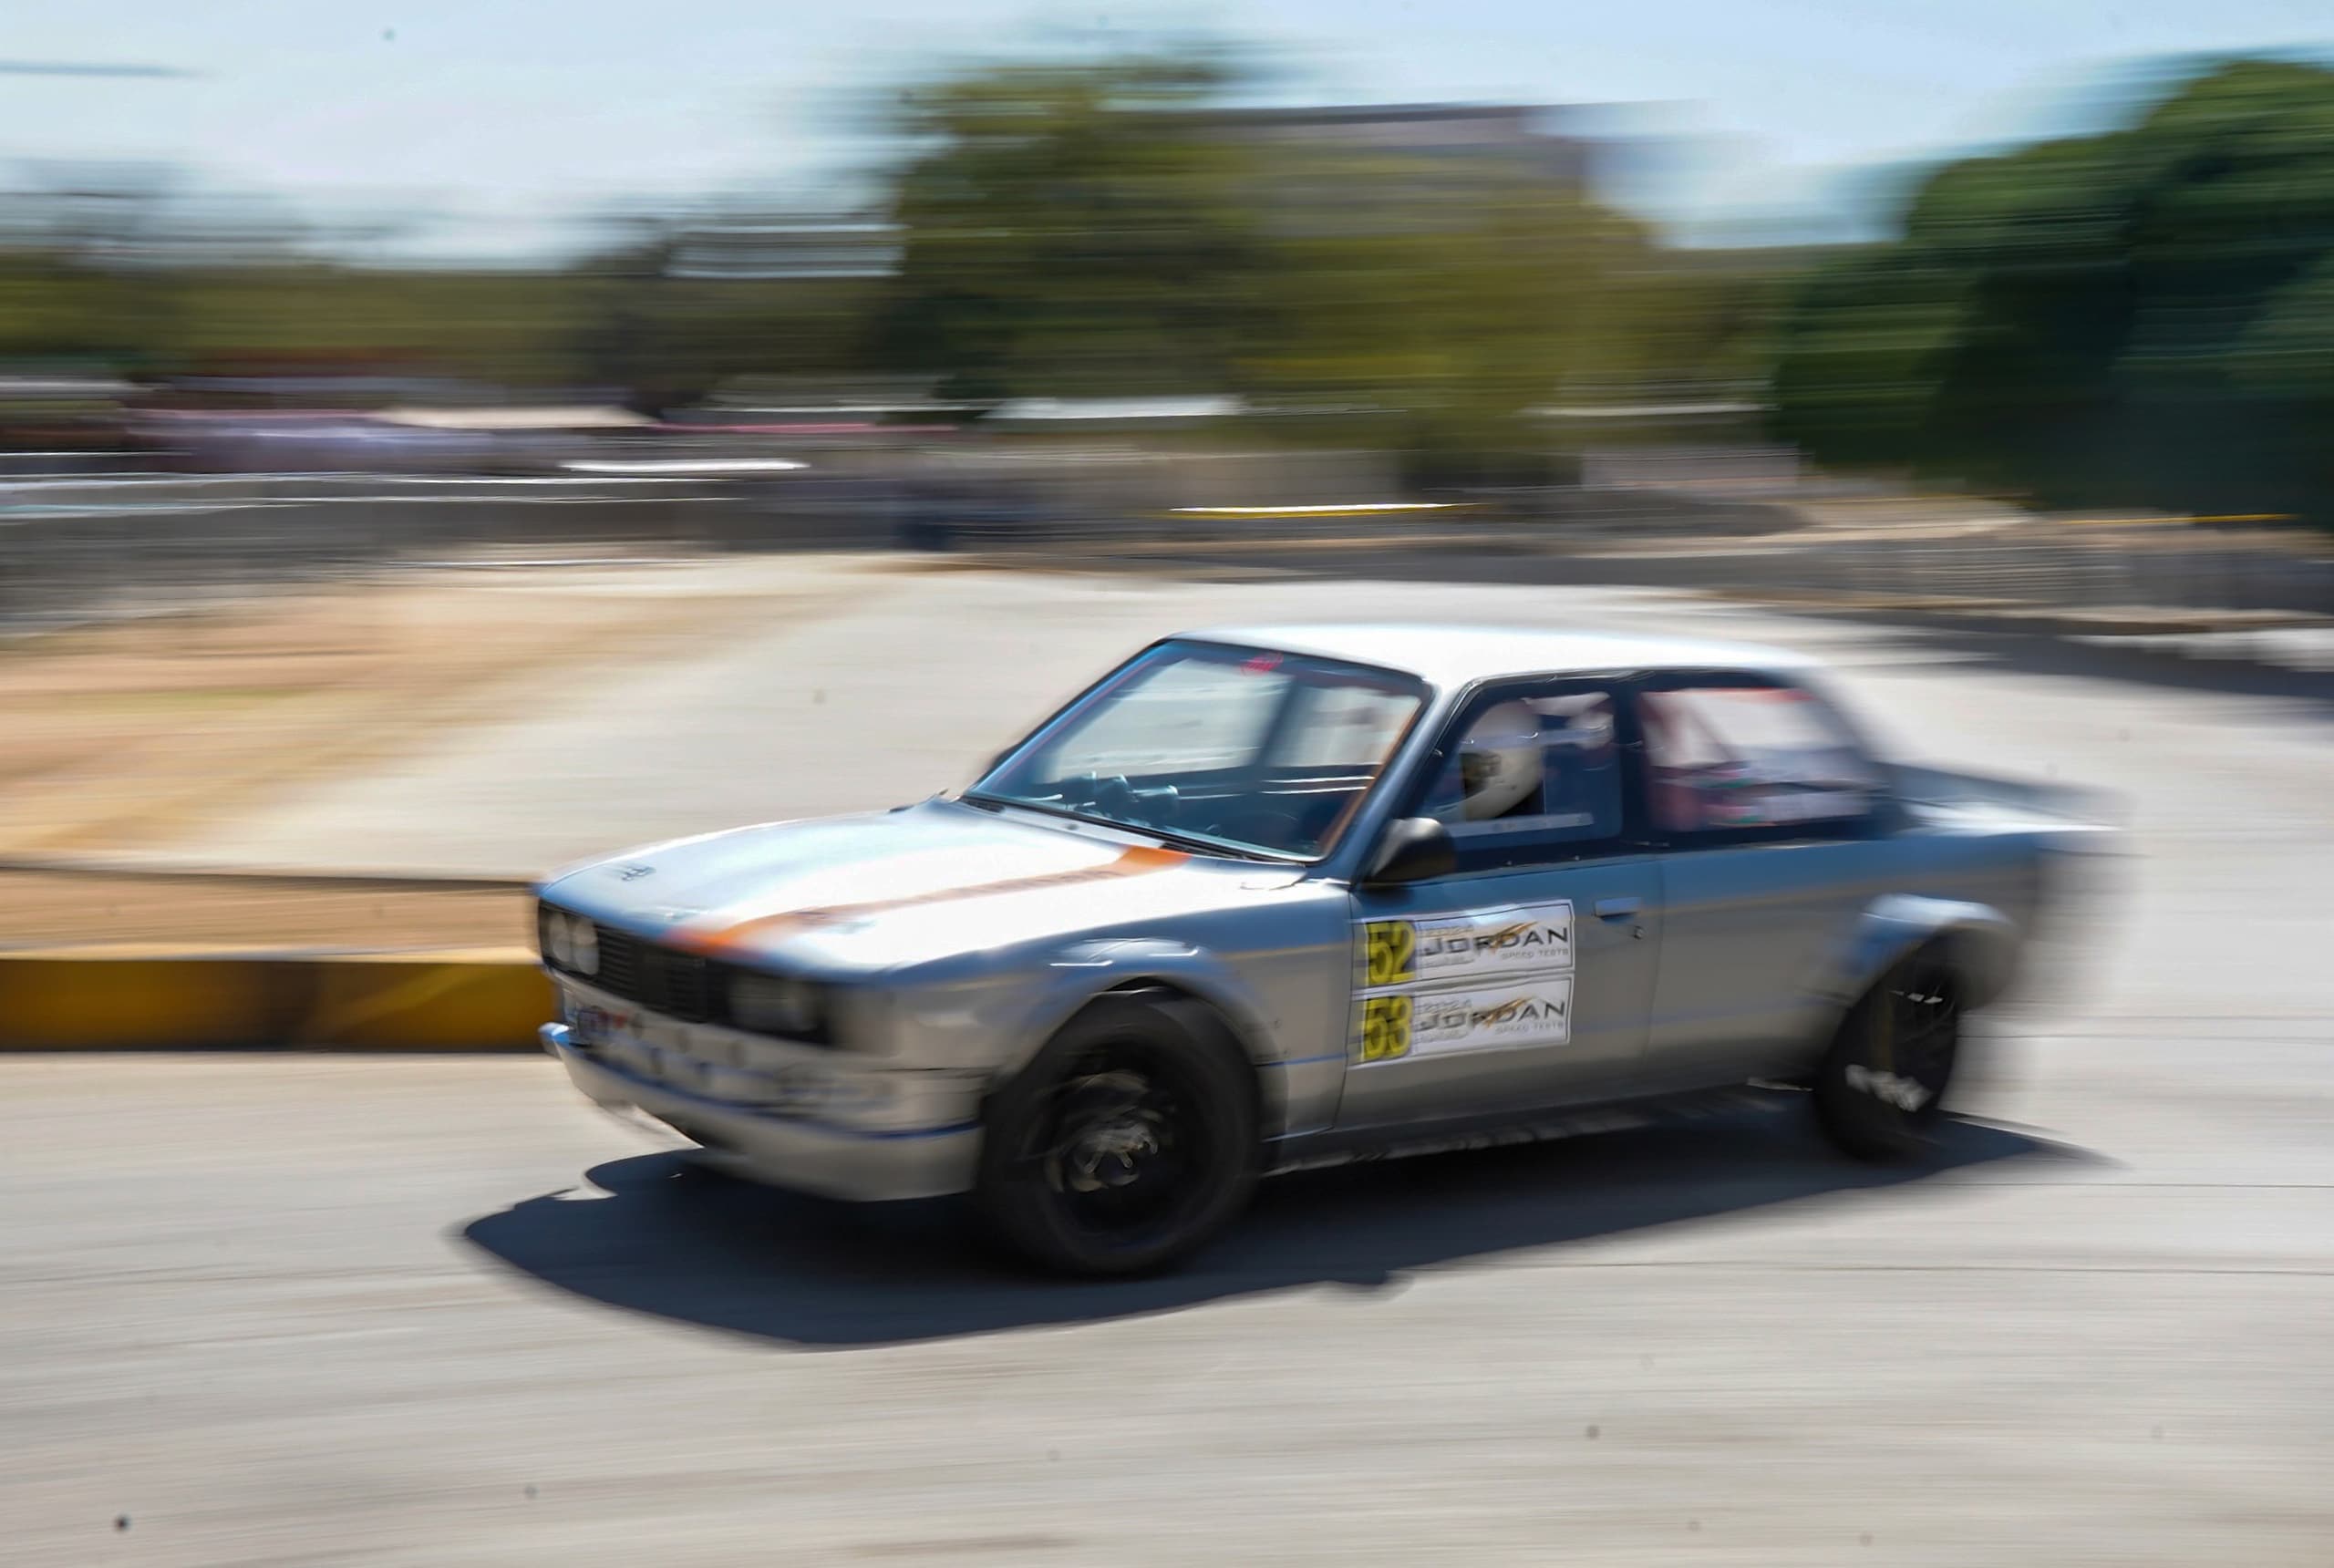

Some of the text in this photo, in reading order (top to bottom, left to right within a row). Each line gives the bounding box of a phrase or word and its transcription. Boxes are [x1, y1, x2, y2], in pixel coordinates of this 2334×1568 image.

[1368, 921, 1416, 985] 52
[1420, 926, 1568, 955] JORDAN
[1416, 1000, 1565, 1032] JORDAN
